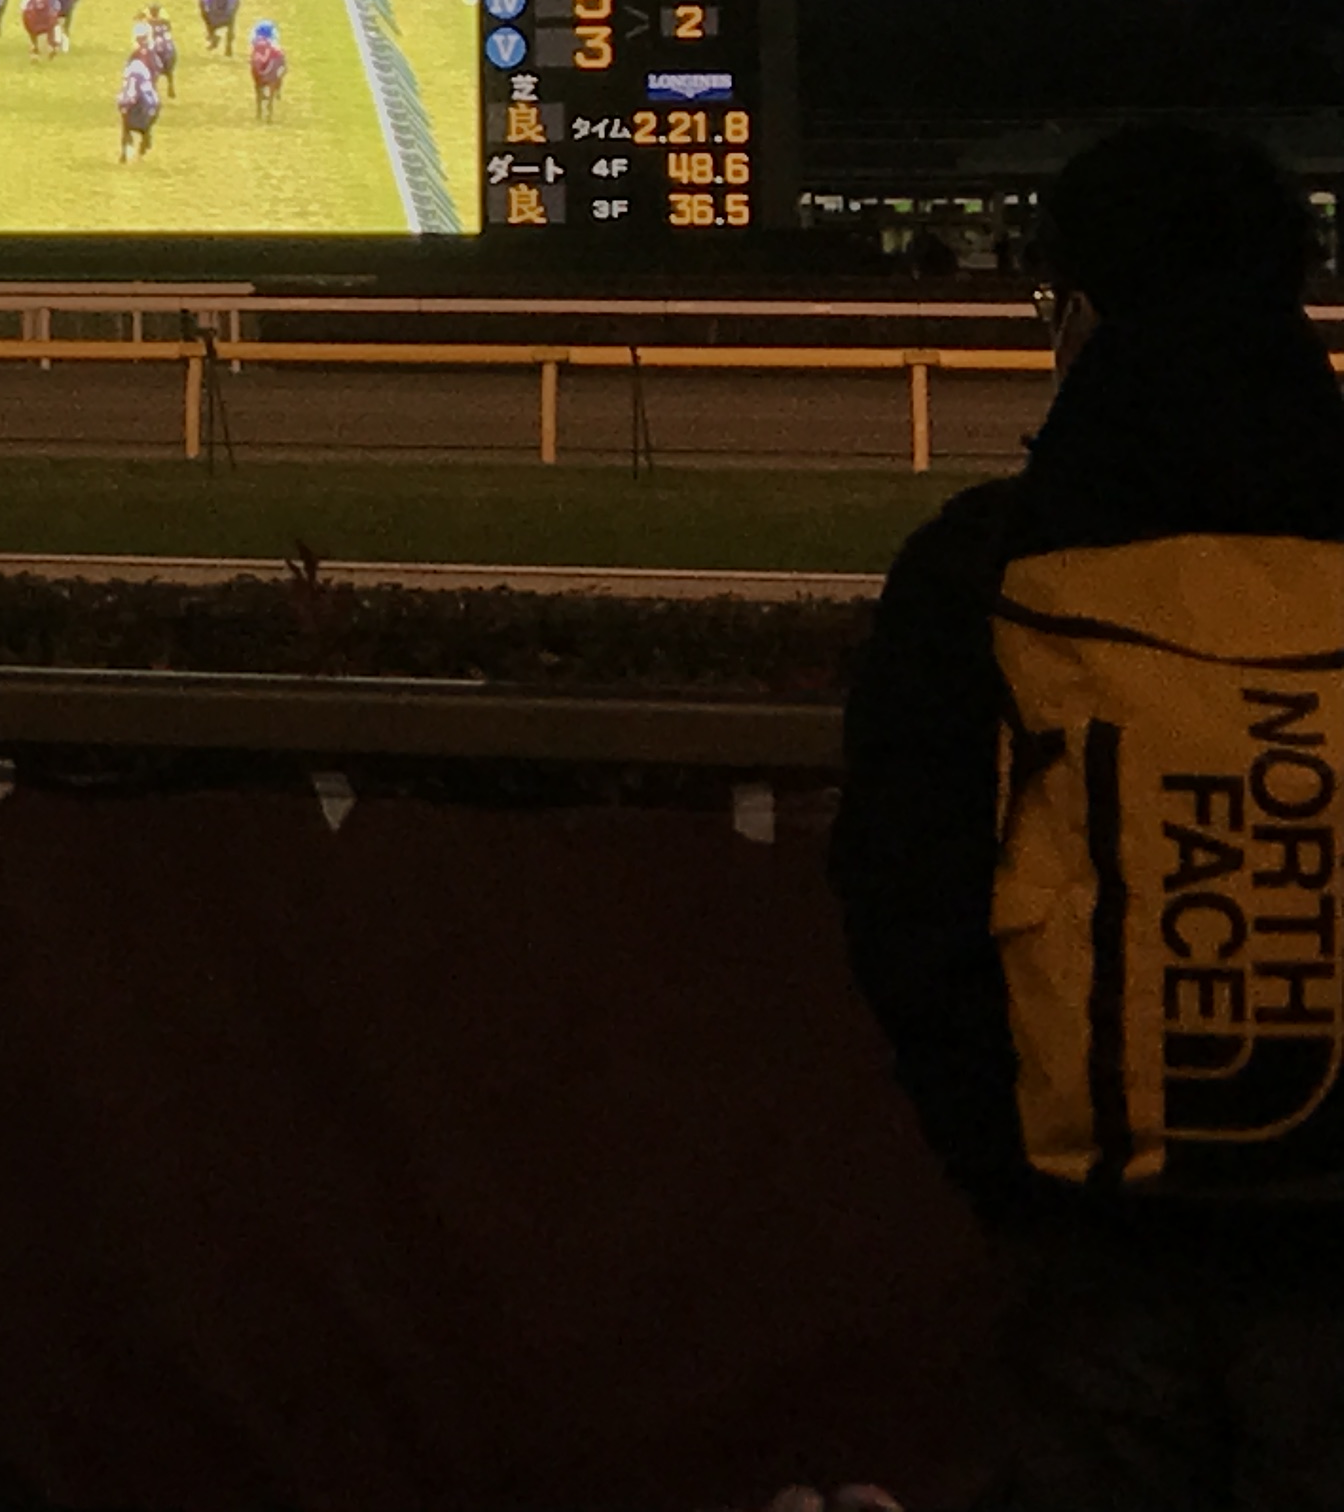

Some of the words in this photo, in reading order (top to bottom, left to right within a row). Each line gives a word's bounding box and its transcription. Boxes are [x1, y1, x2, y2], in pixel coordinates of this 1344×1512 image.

[676, 5, 704, 39] 2
[574, 26, 613, 70] 3
[511, 74, 539, 101] 芝
[507, 103, 547, 144] 良
[572, 117, 632, 140] タイム
[632, 110, 751, 145] 2.21.8
[487, 155, 565, 183] ダート
[592, 159, 629, 178] 4F
[668, 152, 750, 185] 48.6
[507, 183, 547, 226] 良
[592, 200, 629, 219] 3F
[669, 193, 750, 226] 36.5
[1241, 688, 1337, 1025] NORTH
[1161, 774, 1249, 1022] FACE
